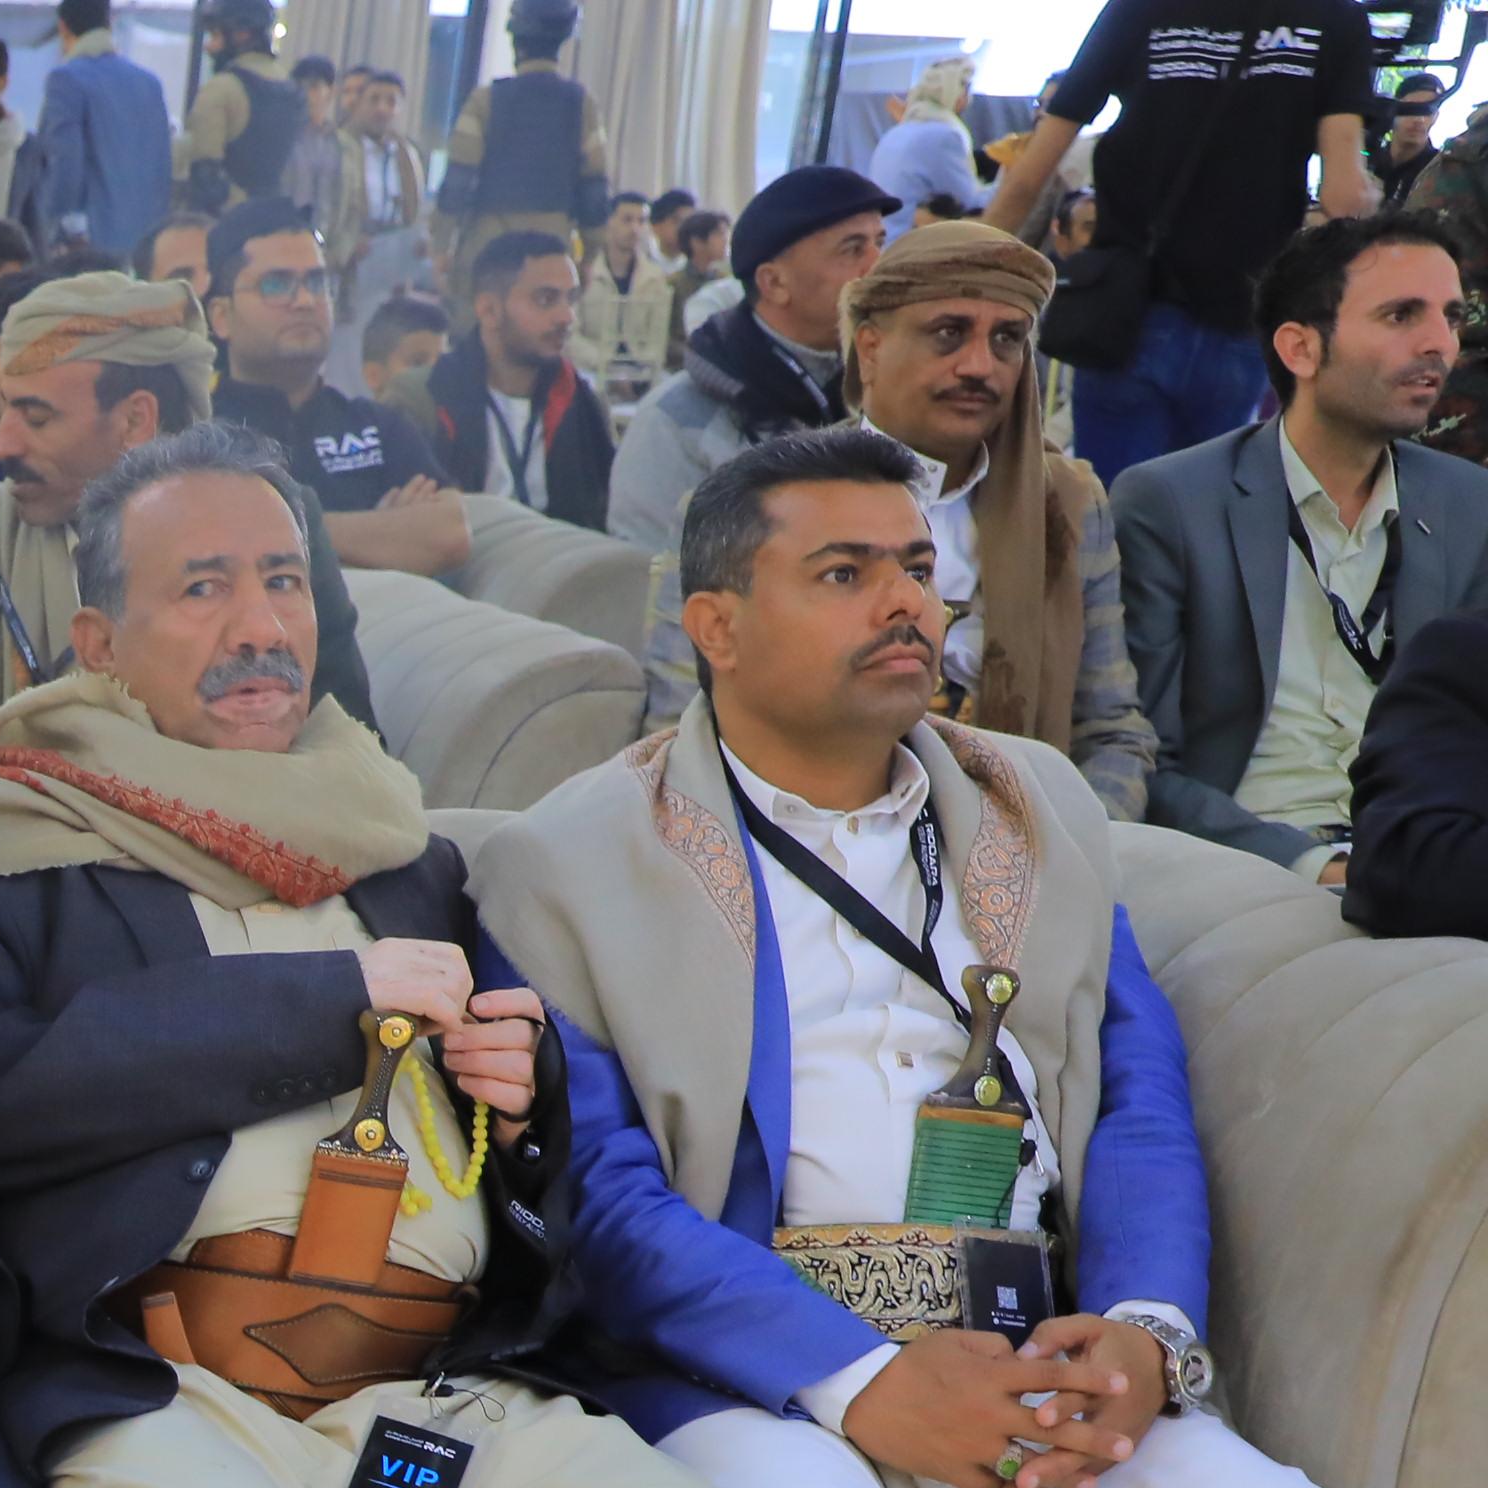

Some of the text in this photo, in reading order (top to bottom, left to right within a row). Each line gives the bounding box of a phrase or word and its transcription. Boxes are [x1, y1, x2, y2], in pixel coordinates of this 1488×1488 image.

[314, 426, 381, 457] RAC
[925, 823, 938, 886] RIDDARA
[511, 1200, 544, 1231] RIDD
[424, 1441, 457, 1459] RAC
[382, 1454, 440, 1487] VIP
